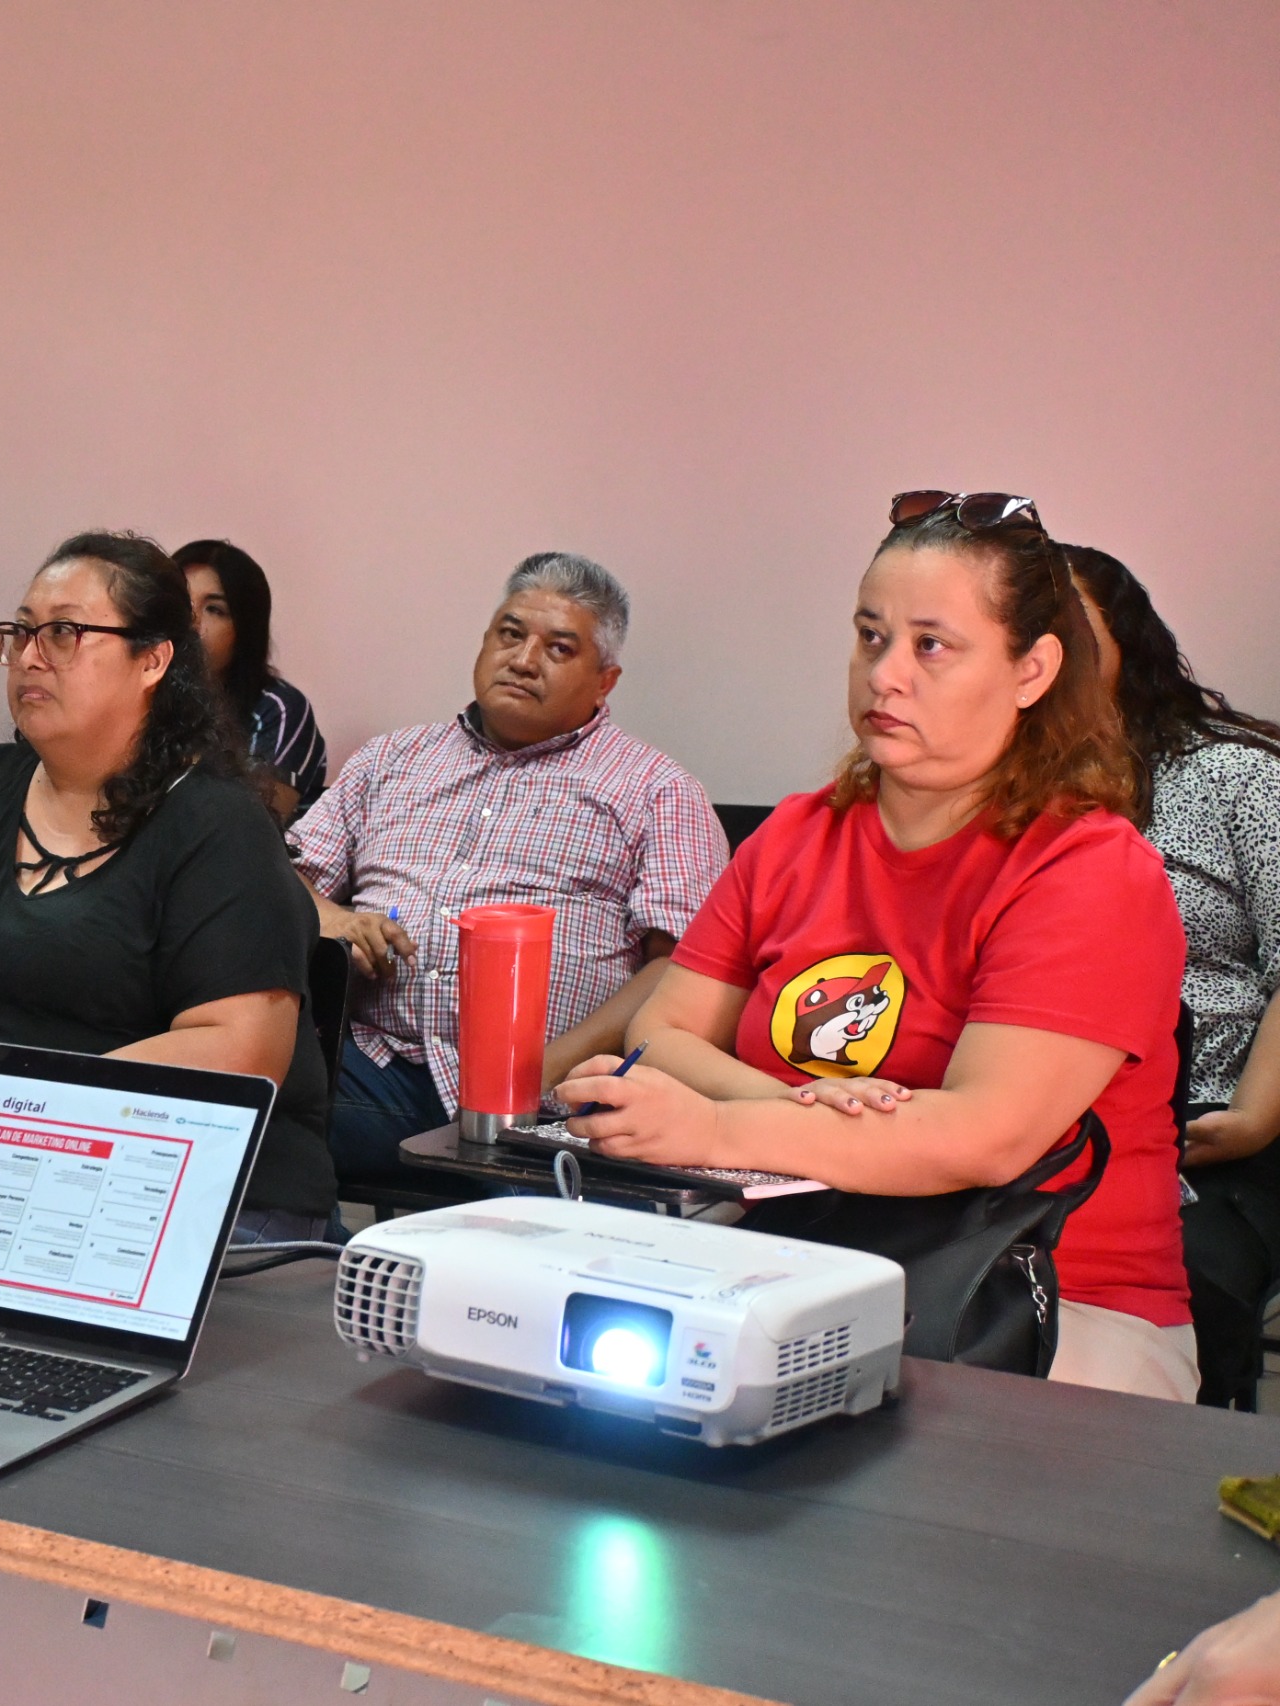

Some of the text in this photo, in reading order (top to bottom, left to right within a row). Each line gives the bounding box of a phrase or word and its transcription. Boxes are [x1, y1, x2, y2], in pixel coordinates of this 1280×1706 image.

[2, 1096, 46, 1113] digital
[132, 1107, 170, 1120] Hacienda
[12, 1130, 24, 1142] DE
[21, 1131, 66, 1149] MARKETING
[64, 1138, 93, 1153] ONLINE
[467, 1306, 518, 1330] EPSON
